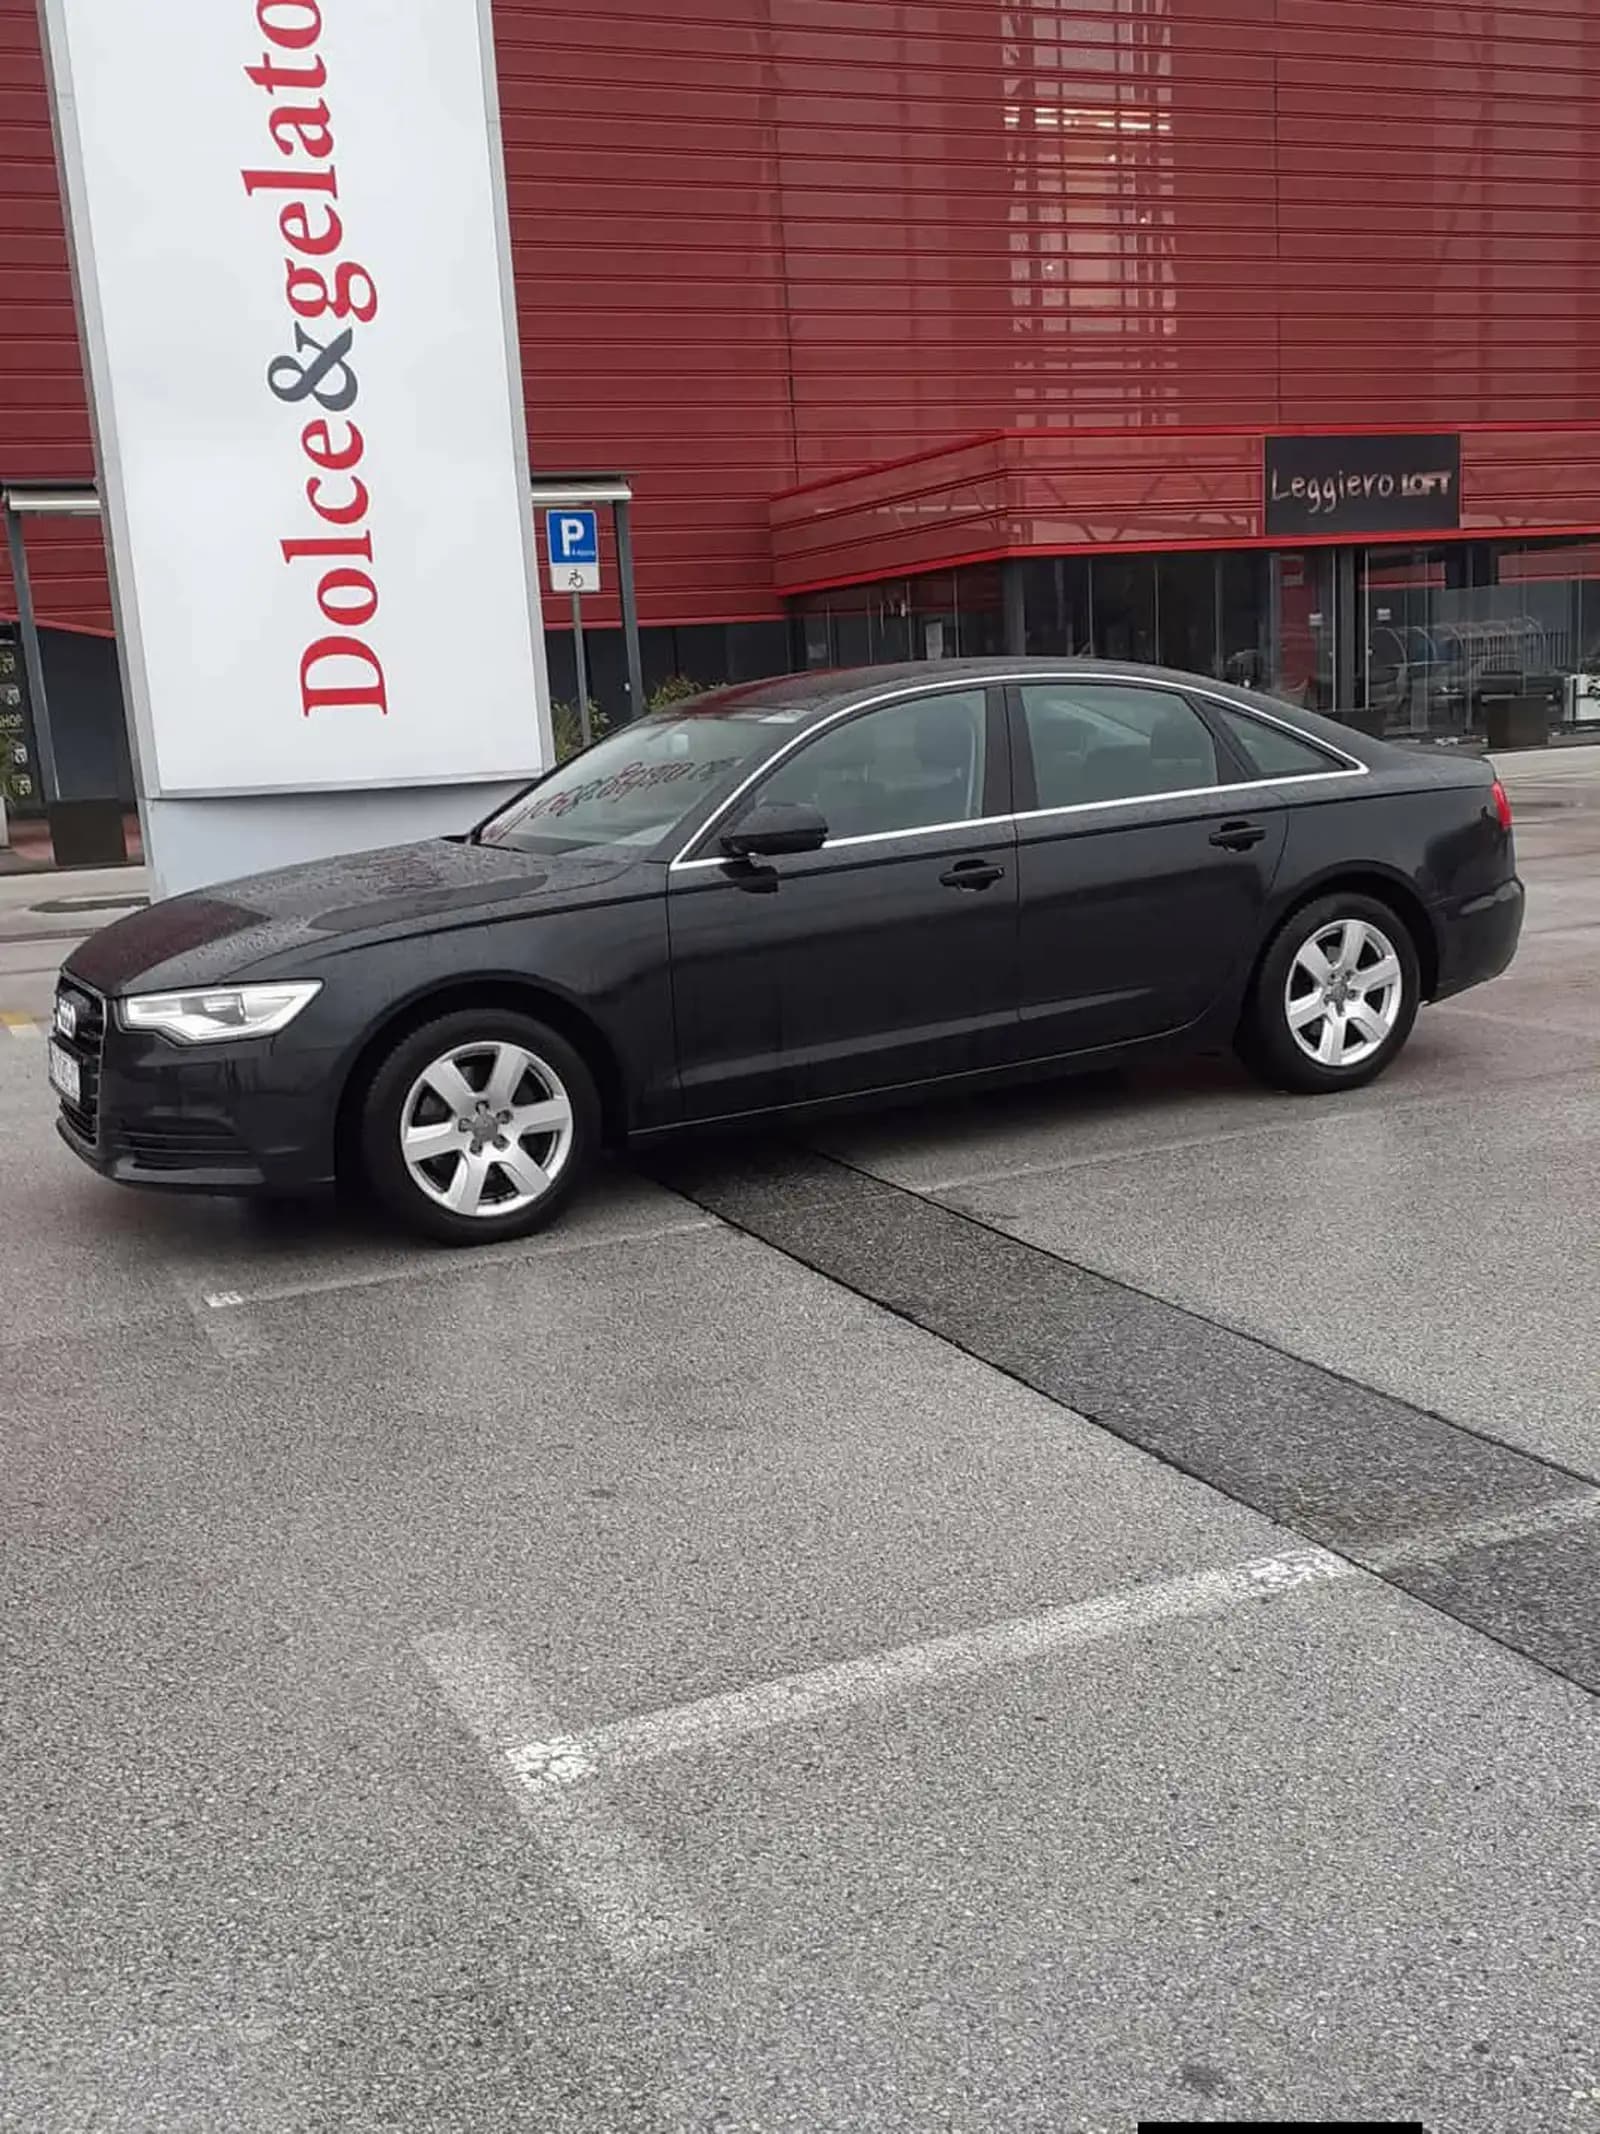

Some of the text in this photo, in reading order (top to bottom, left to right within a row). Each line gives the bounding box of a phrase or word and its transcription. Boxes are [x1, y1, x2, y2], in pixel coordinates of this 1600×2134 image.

[240, 0, 388, 717] Dolce&gelato
[1271, 467, 1451, 514] Leggiero LOFT
[561, 518, 585, 556] P
